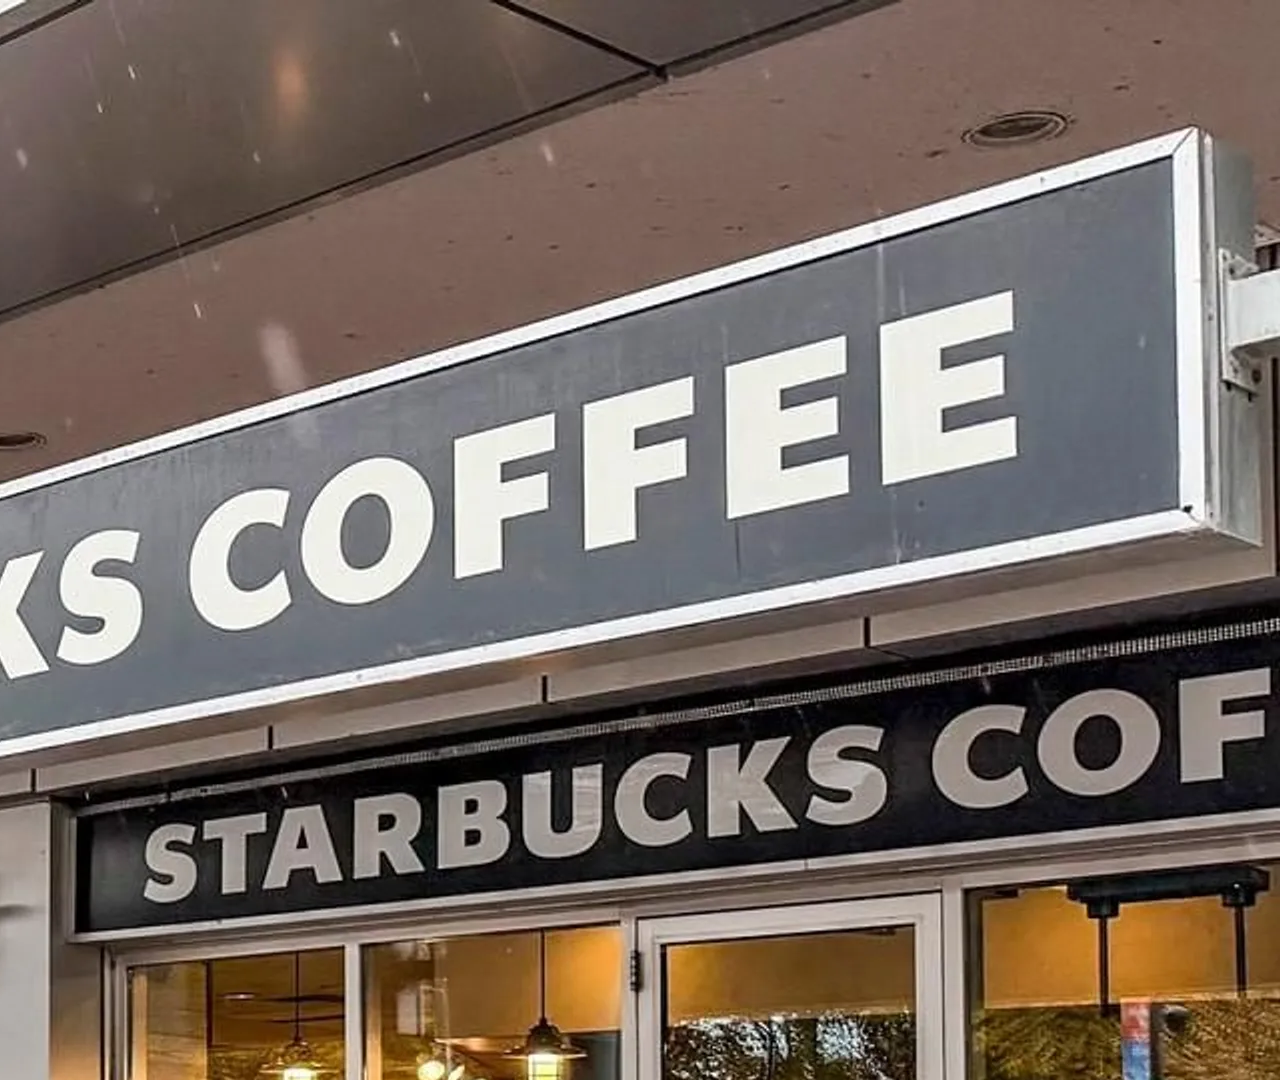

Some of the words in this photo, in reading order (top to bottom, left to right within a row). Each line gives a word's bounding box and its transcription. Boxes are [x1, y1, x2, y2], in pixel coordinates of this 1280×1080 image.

[188, 288, 1018, 633] COFFEE
[142, 725, 888, 904] STARBUCKS
[931, 666, 1271, 810] COF
